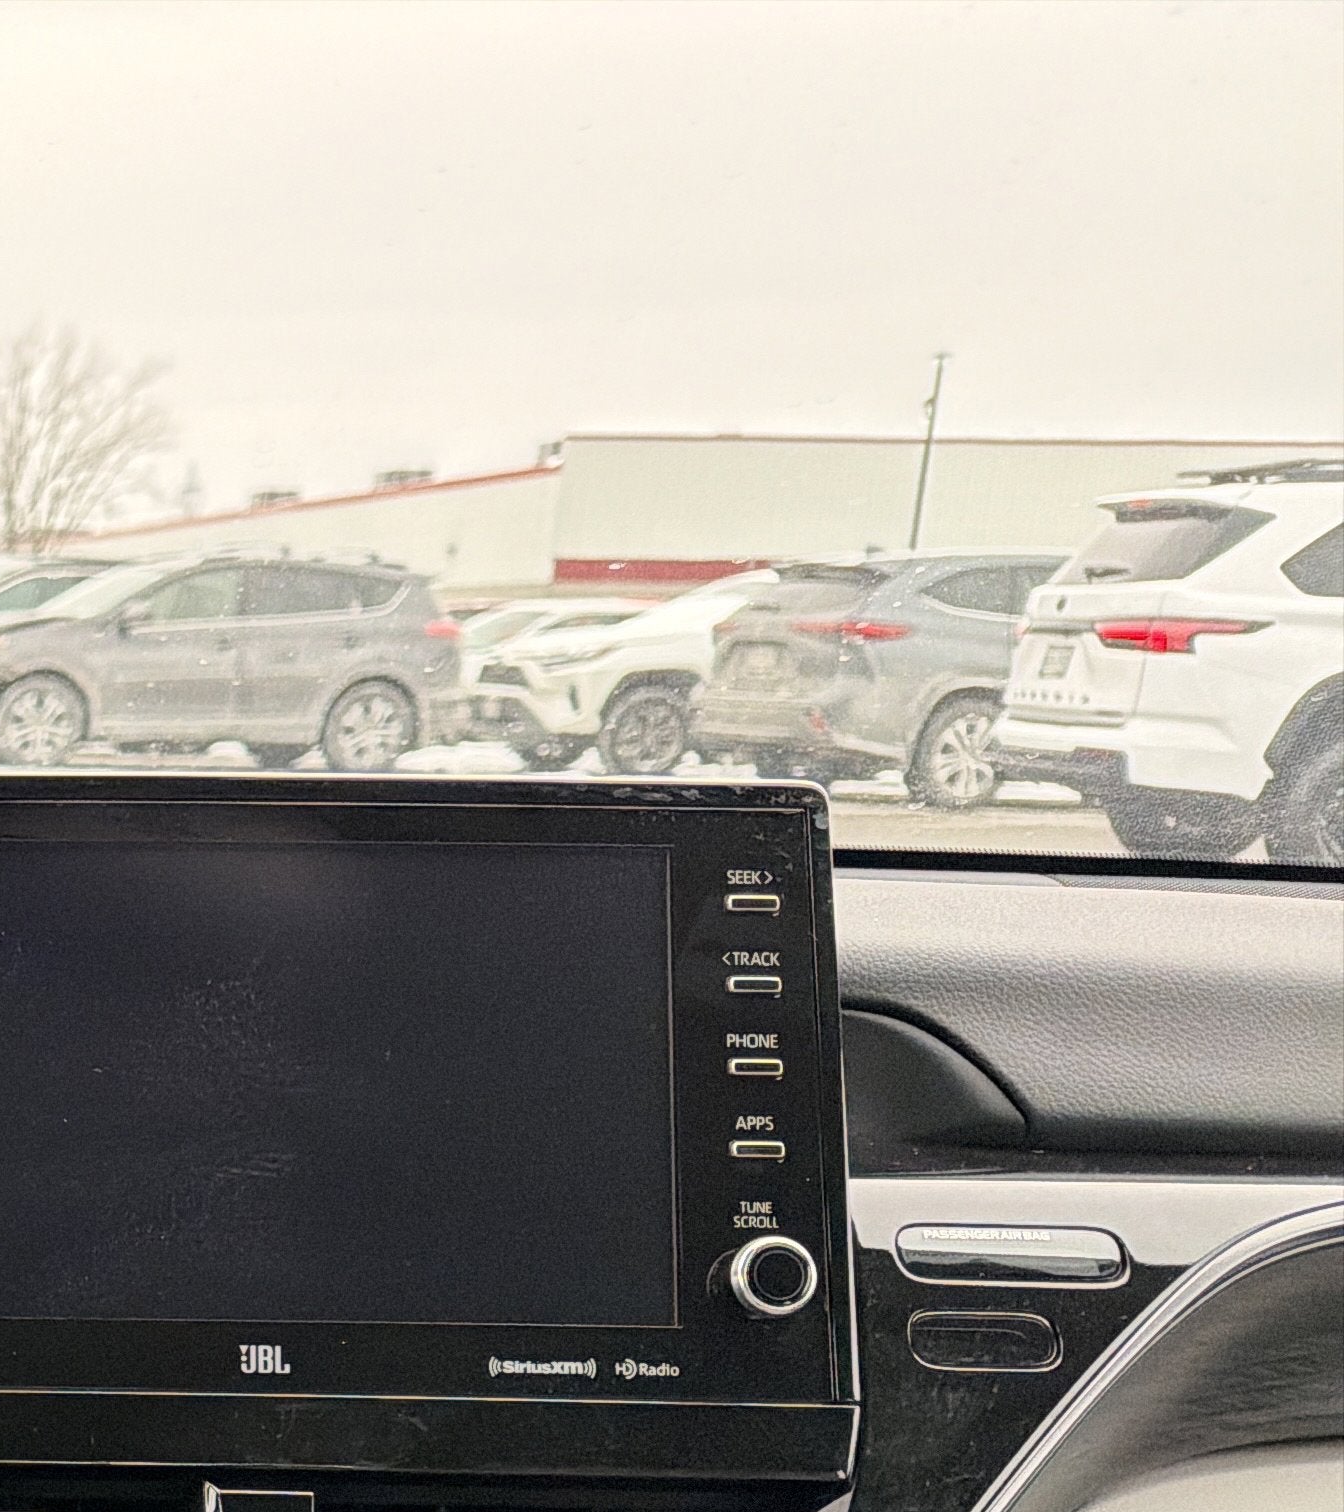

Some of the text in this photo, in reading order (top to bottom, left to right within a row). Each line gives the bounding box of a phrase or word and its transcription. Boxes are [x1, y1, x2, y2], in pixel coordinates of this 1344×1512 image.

[727, 1034, 778, 1048] PHONE
[736, 1116, 773, 1130] APPS
[740, 1201, 772, 1213] TUNE
[734, 1216, 779, 1228] SCROLL
[923, 1229, 1051, 1242] PASSENGER AIR BAG
[240, 1345, 290, 1373] JBL
[639, 1363, 679, 1376] Radio
